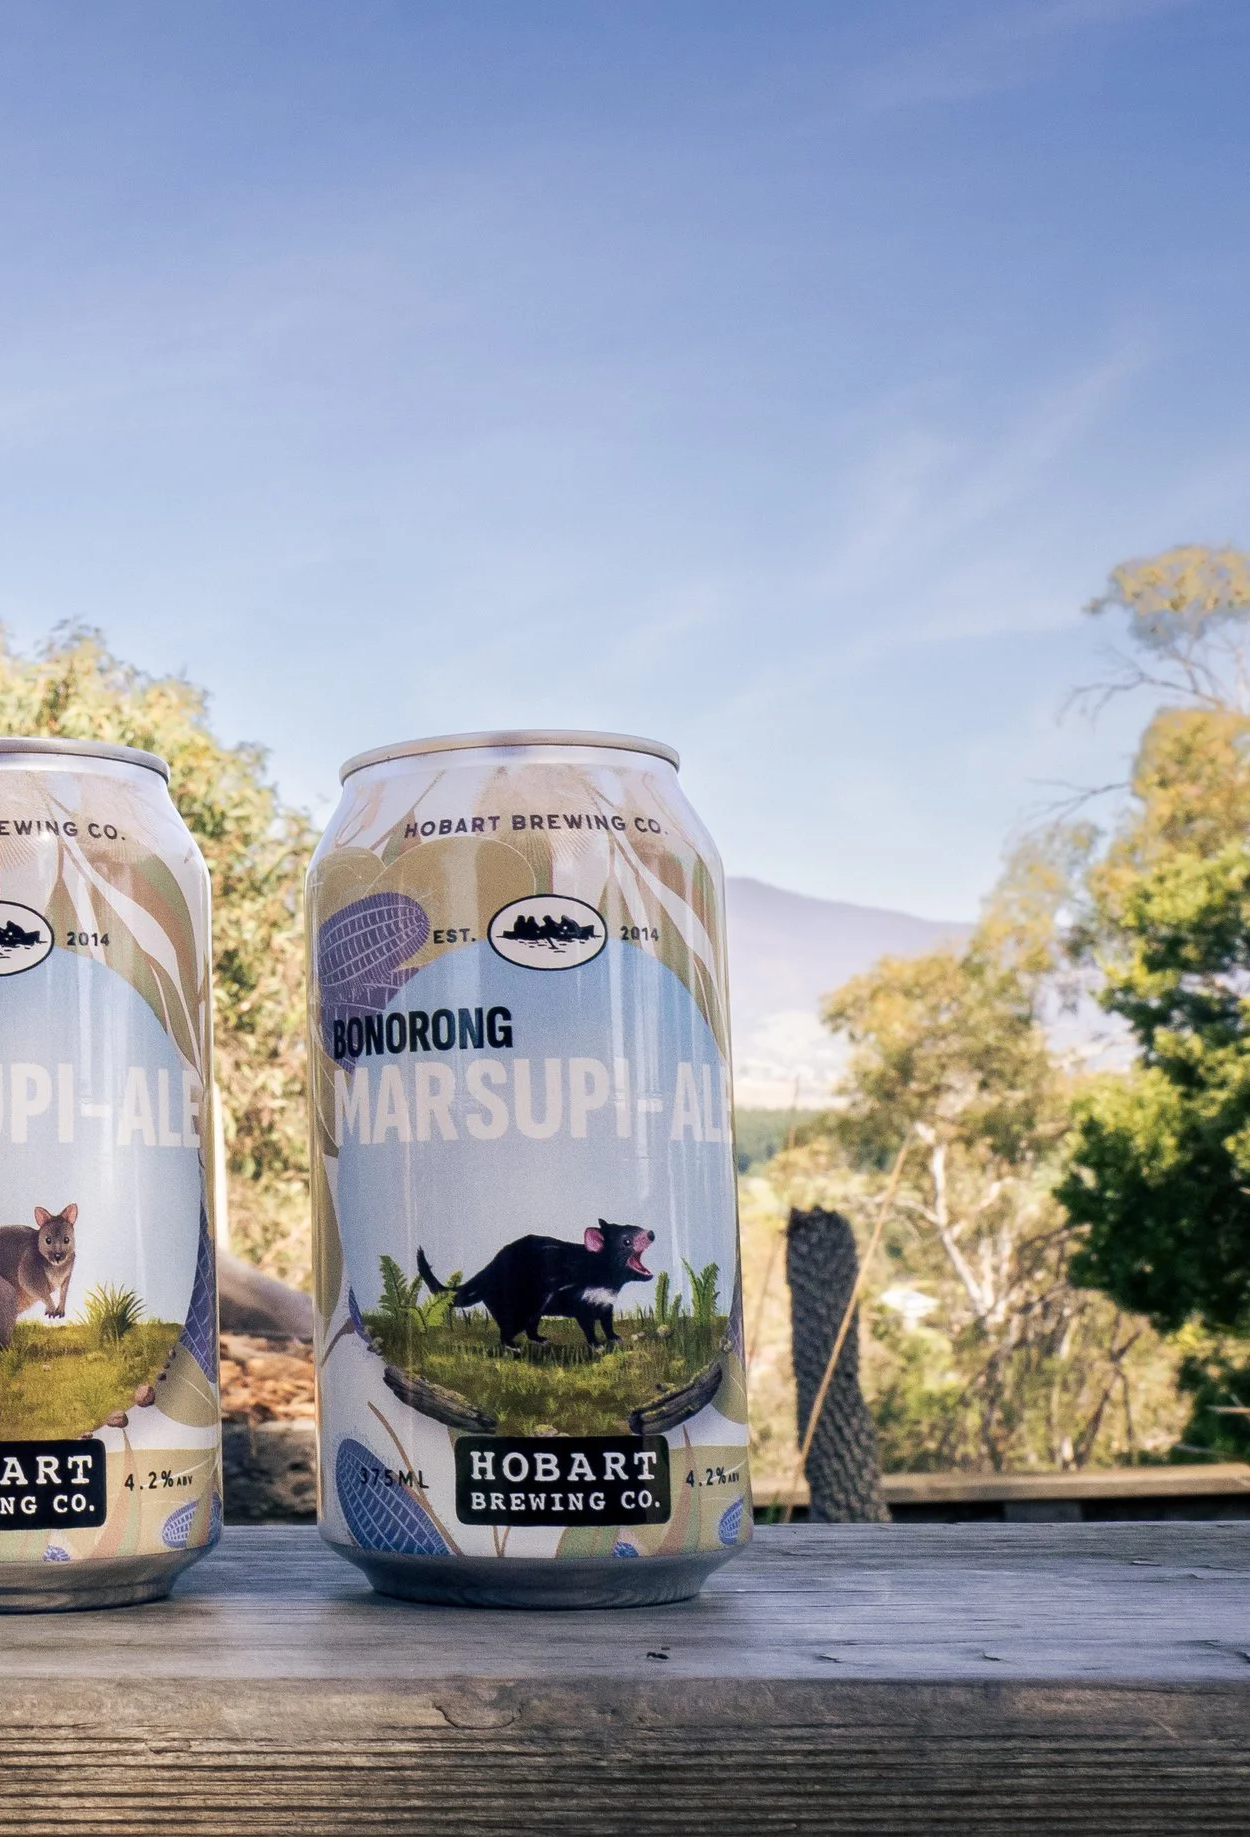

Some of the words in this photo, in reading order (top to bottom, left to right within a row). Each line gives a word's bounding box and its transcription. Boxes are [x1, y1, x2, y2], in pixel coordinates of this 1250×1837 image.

[87, 823, 127, 841] CO.
[404, 815, 501, 838] HOBART
[512, 814, 626, 831] BREWING
[634, 816, 669, 835] CO.
[66, 932, 110, 947] 2014
[433, 928, 476, 944] EST.
[620, 925, 659, 941] 2014
[333, 1006, 514, 1060] BONORONG
[469, 1450, 658, 1481] HOBART
[123, 1470, 174, 1491] 4.2%
[360, 1467, 429, 1489] 375ML
[52, 1494, 96, 1513] CO.
[471, 1491, 606, 1511] BREWING
[620, 1490, 661, 1510] CO.
